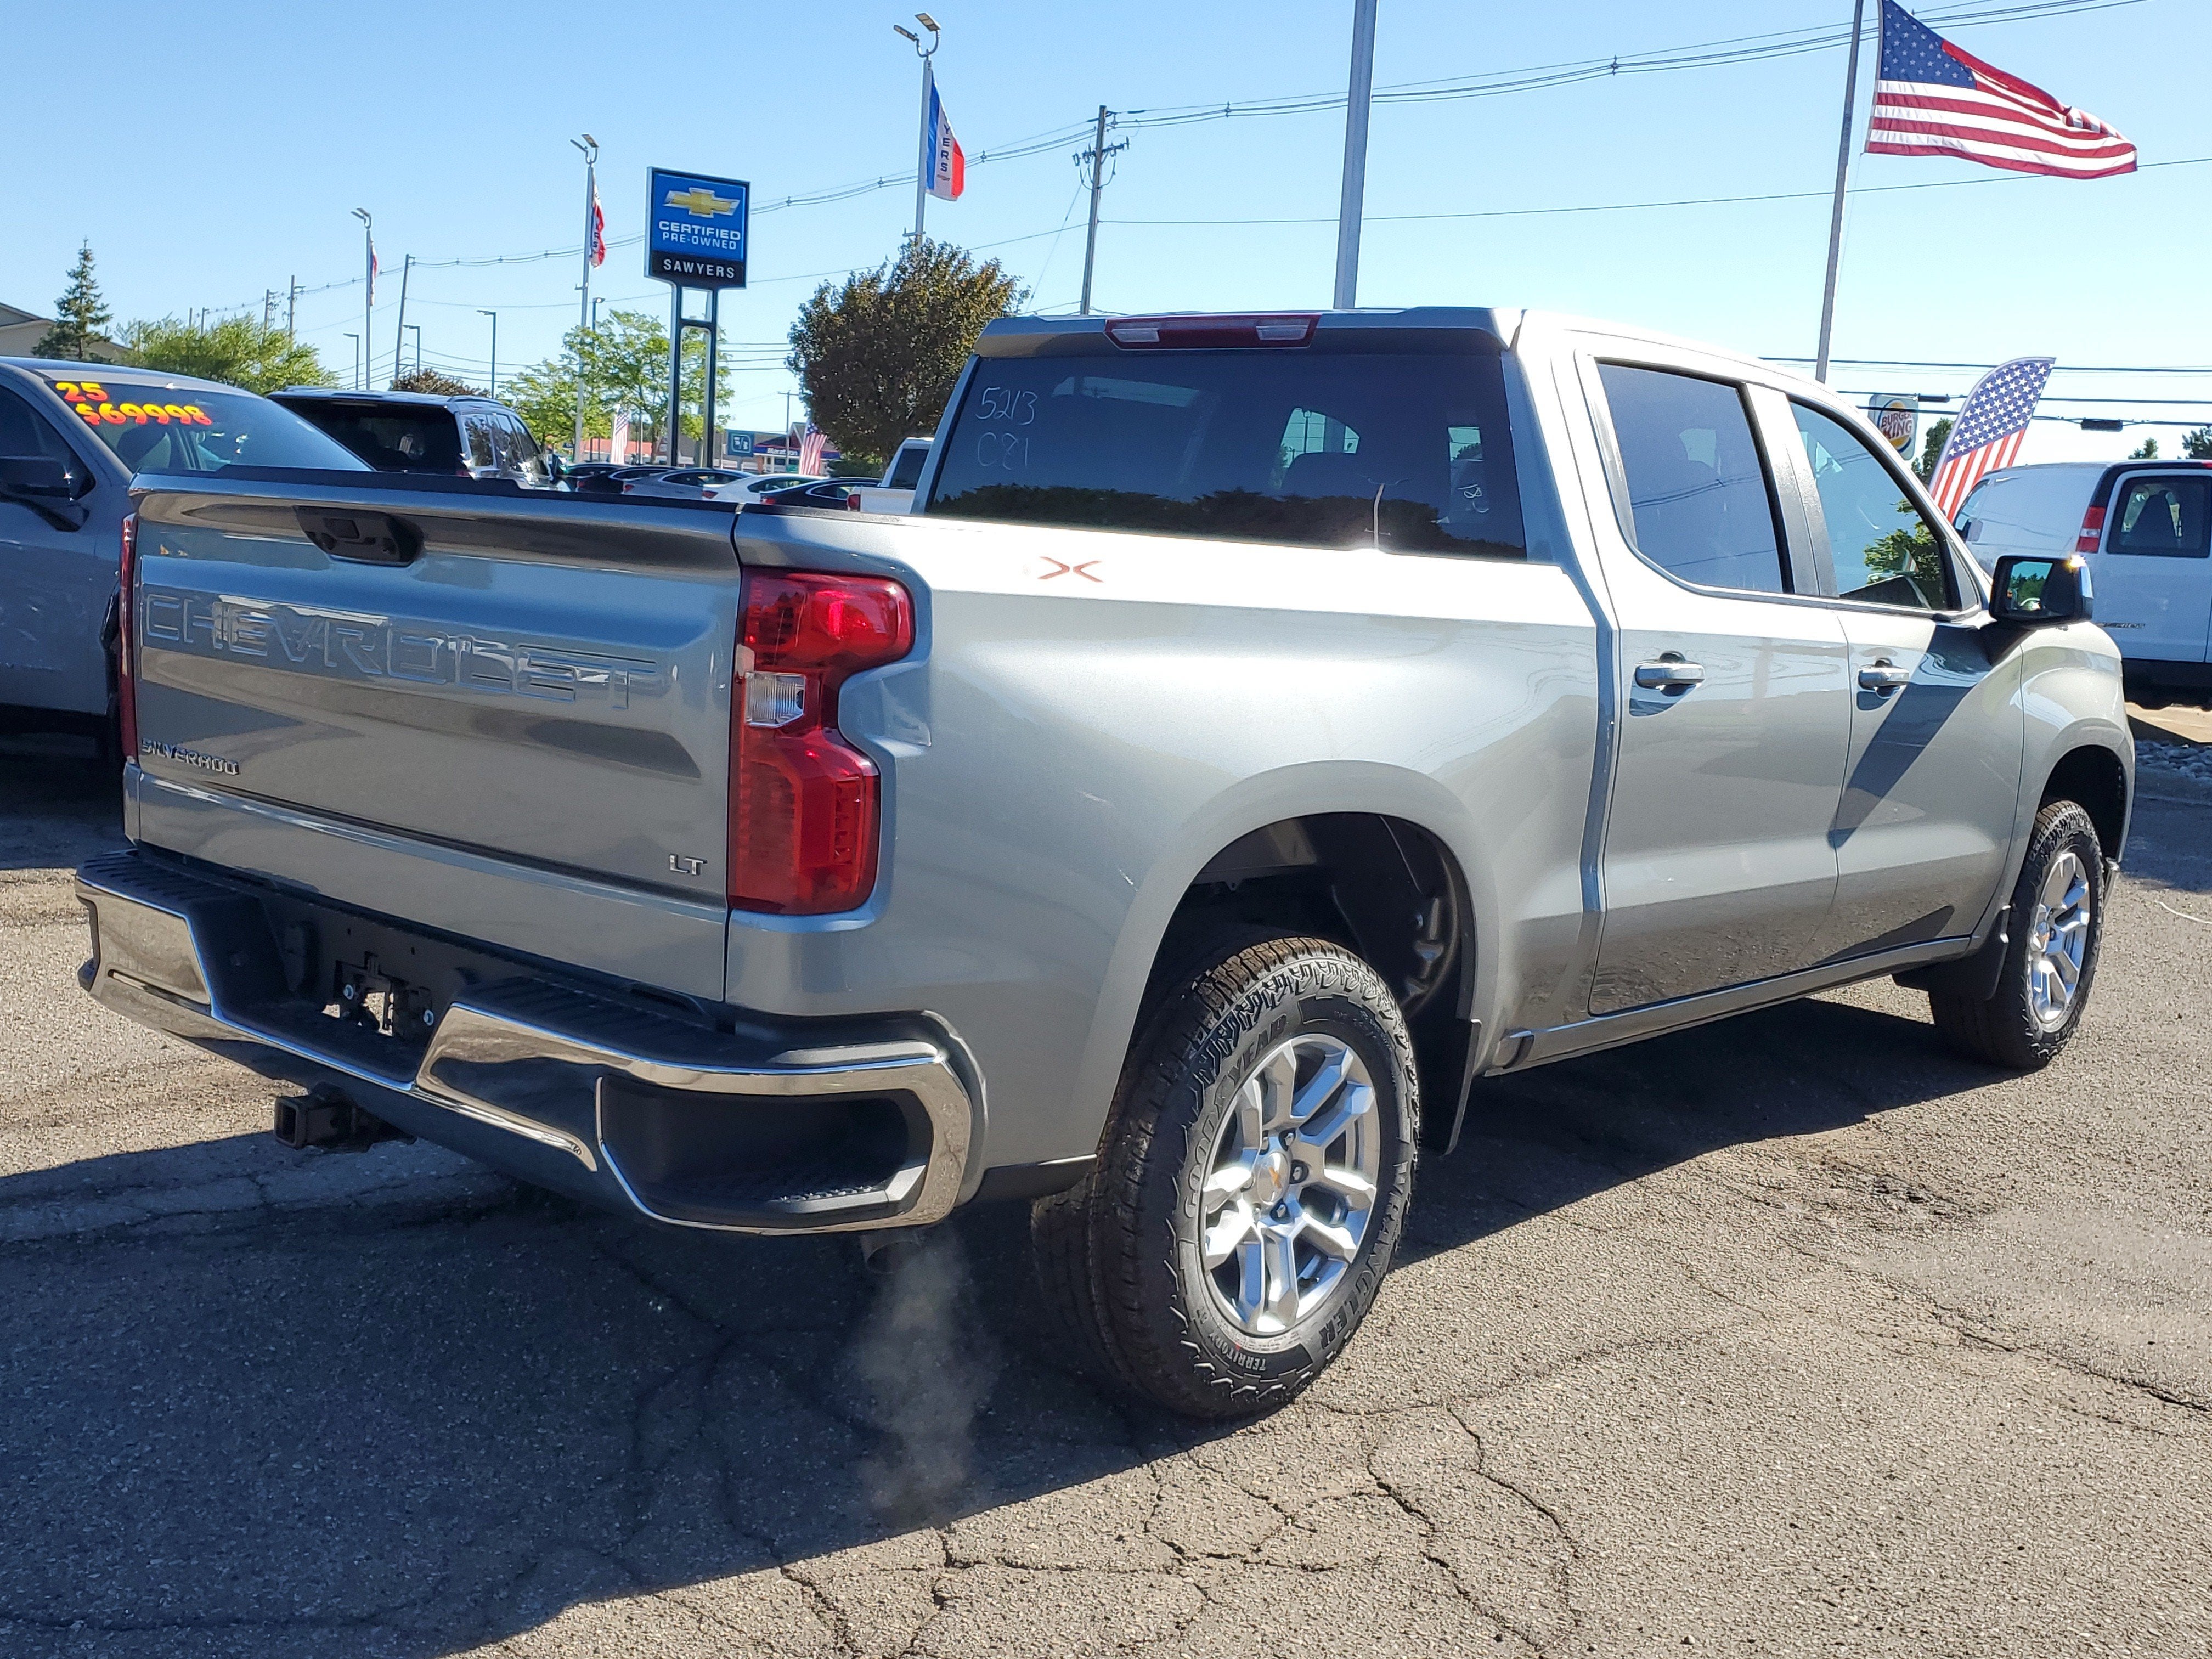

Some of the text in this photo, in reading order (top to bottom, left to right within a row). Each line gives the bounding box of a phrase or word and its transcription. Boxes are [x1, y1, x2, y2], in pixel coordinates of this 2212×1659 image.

[658, 221, 741, 240] CERTIFIED
[662, 232, 737, 250] PRE-OWNED
[663, 259, 735, 279] SAWYERS
[55, 382, 108, 402] 25
[75, 403, 212, 425] $69998
[975, 387, 1037, 425] 5213
[1882, 411, 1912, 428] BURGER
[1882, 420, 1912, 439] KING
[146, 594, 657, 709] CHEVROLET
[142, 737, 240, 776] SILVERADO
[669, 853, 708, 876] LT
[1184, 1013, 1287, 1218] GOODYEAR
[1208, 1332, 1266, 1371] TERRITORY
